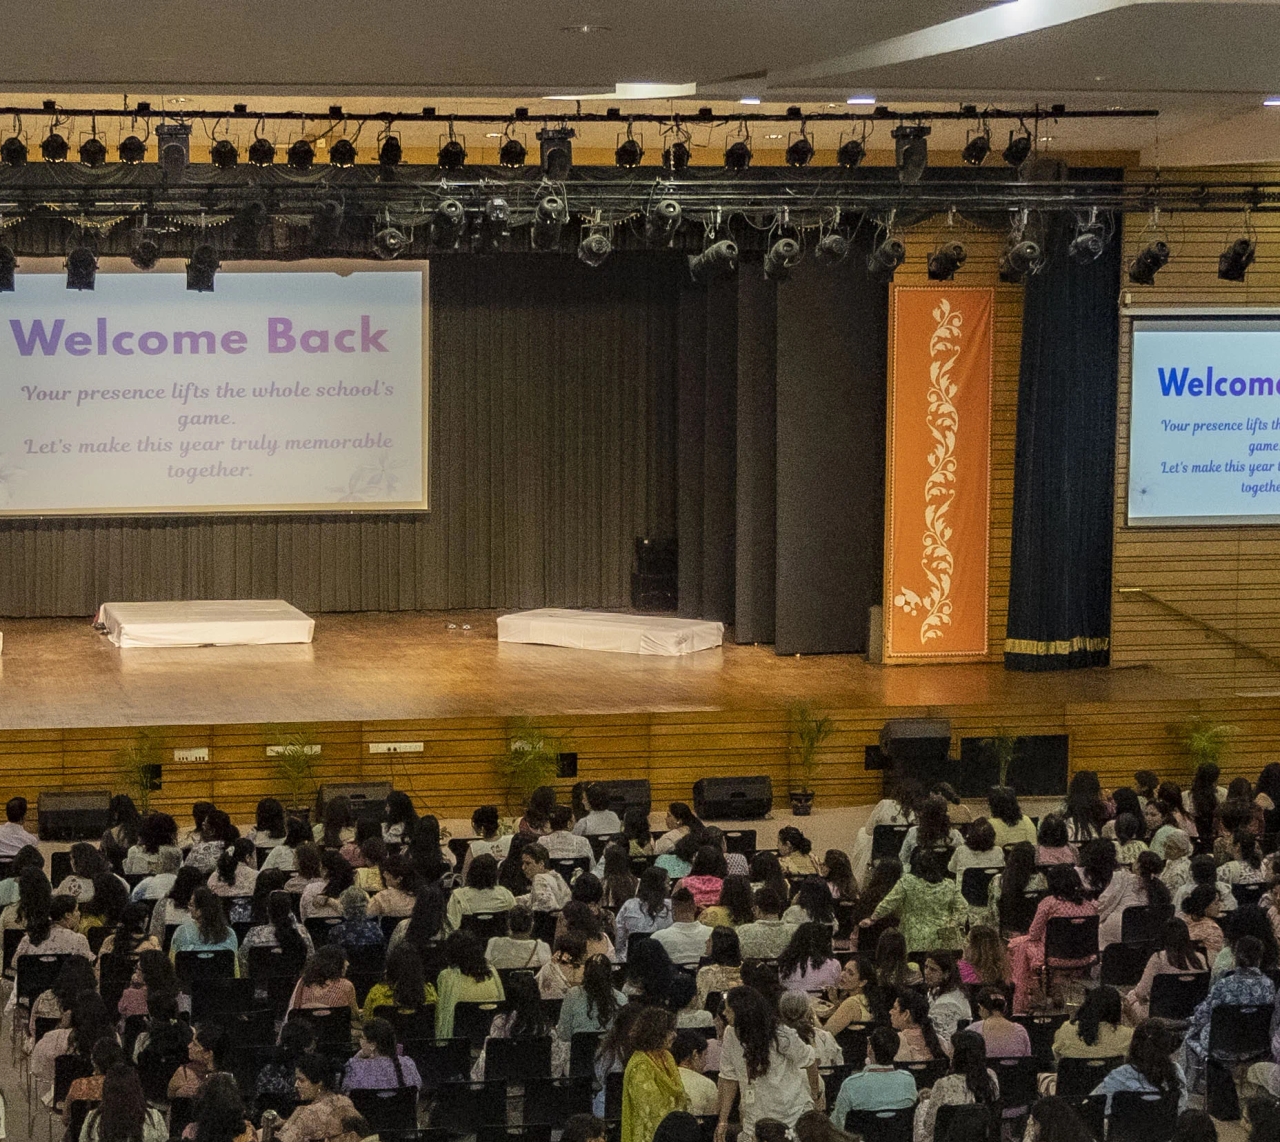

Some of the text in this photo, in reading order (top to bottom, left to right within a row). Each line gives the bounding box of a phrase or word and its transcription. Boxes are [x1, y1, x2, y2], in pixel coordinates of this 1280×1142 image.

[8, 314, 390, 357] Welcome Back
[20, 381, 394, 407] Your presence lifts the whole school's
[178, 414, 235, 432] game.
[1161, 420, 1190, 431] Your
[1192, 422, 1243, 436] presence
[1246, 417, 1268, 435] lifts
[23, 433, 395, 458] Let's make this year truly memorable
[1248, 442, 1280, 457] game.
[168, 462, 252, 484] together.
[1161, 462, 1188, 473] Let's
[1191, 460, 1221, 472] make
[1224, 459, 1245, 472] this
[1248, 463, 1274, 477] year
